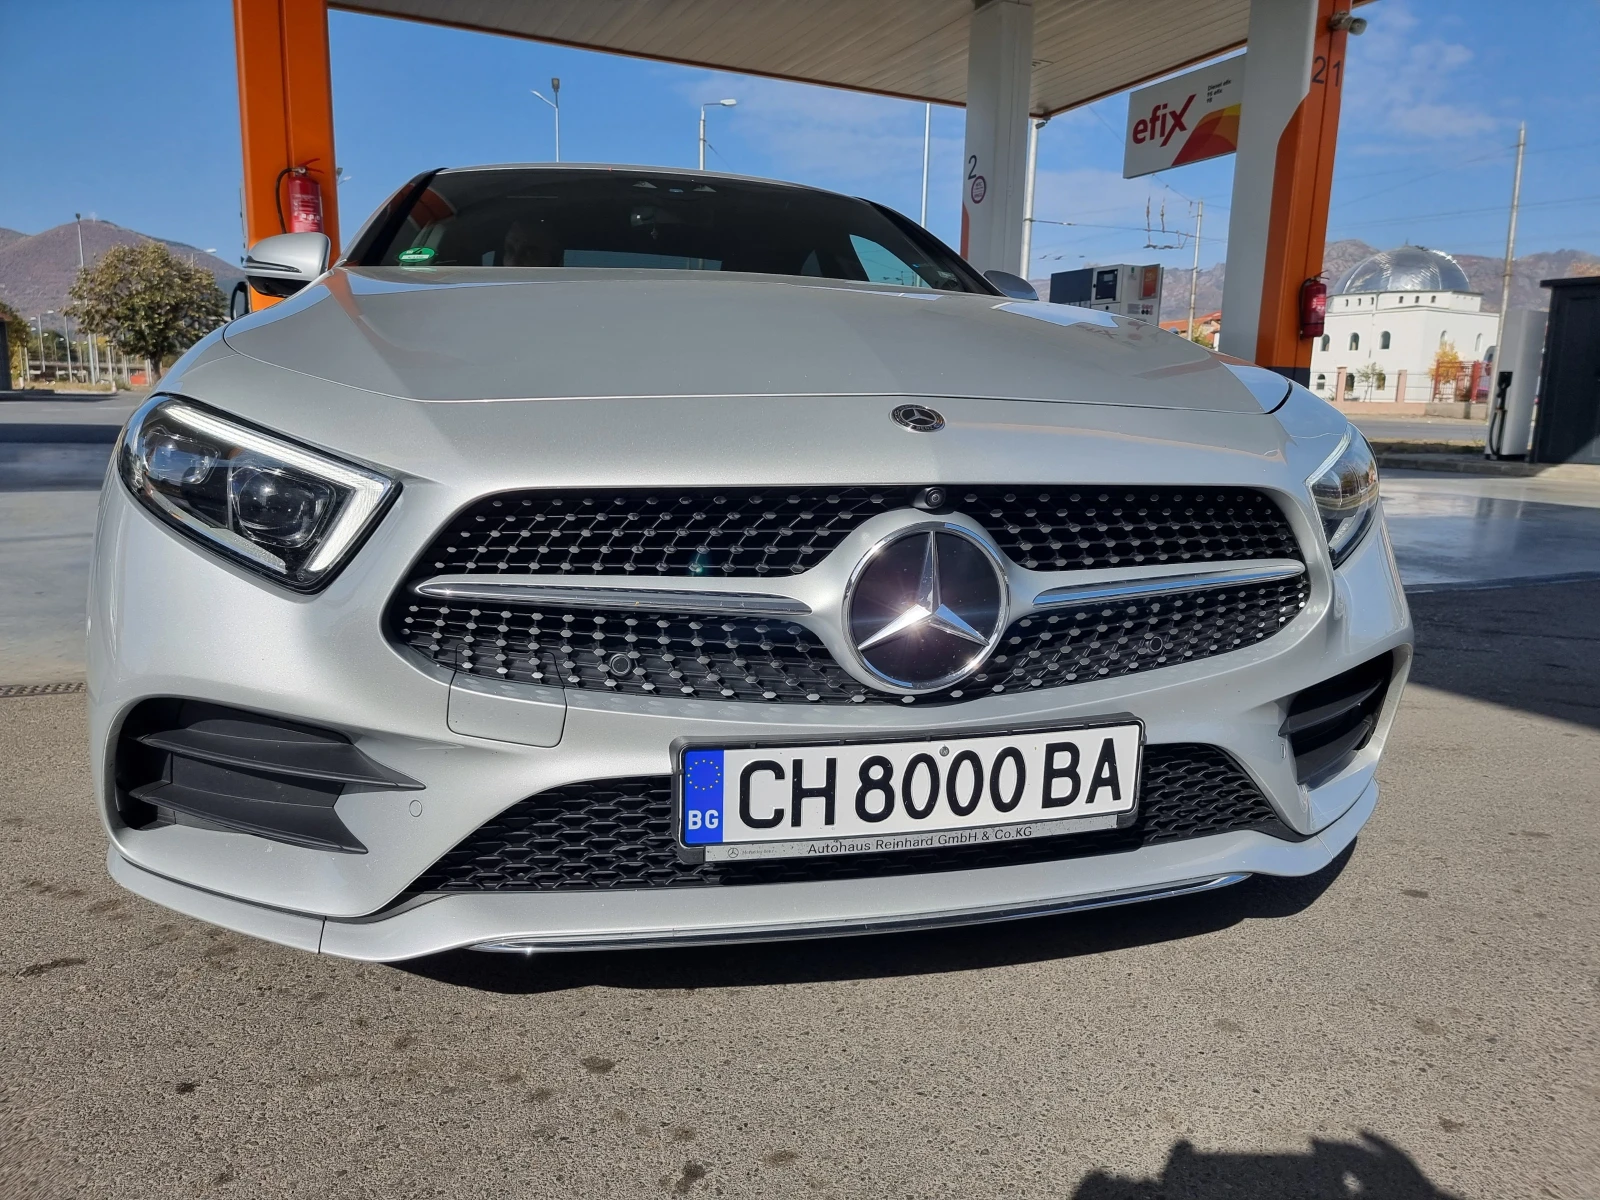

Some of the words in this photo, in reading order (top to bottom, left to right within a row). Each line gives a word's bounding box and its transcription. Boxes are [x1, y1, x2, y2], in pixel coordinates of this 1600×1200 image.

[1312, 56, 1326, 84] 2
[1333, 60, 1341, 87] 1
[1132, 94, 1197, 148] efix
[968, 154, 977, 180] 2
[739, 757, 837, 829] CH
[855, 746, 1026, 823] 8000
[1041, 737, 1122, 809] BA
[688, 809, 719, 830] BG
[807, 840, 871, 855] Autohaus
[875, 835, 933, 850] Reinhard
[938, 832, 977, 845] GmbH
[981, 830, 990, 841] &
[994, 826, 1032, 840] Co.KG
